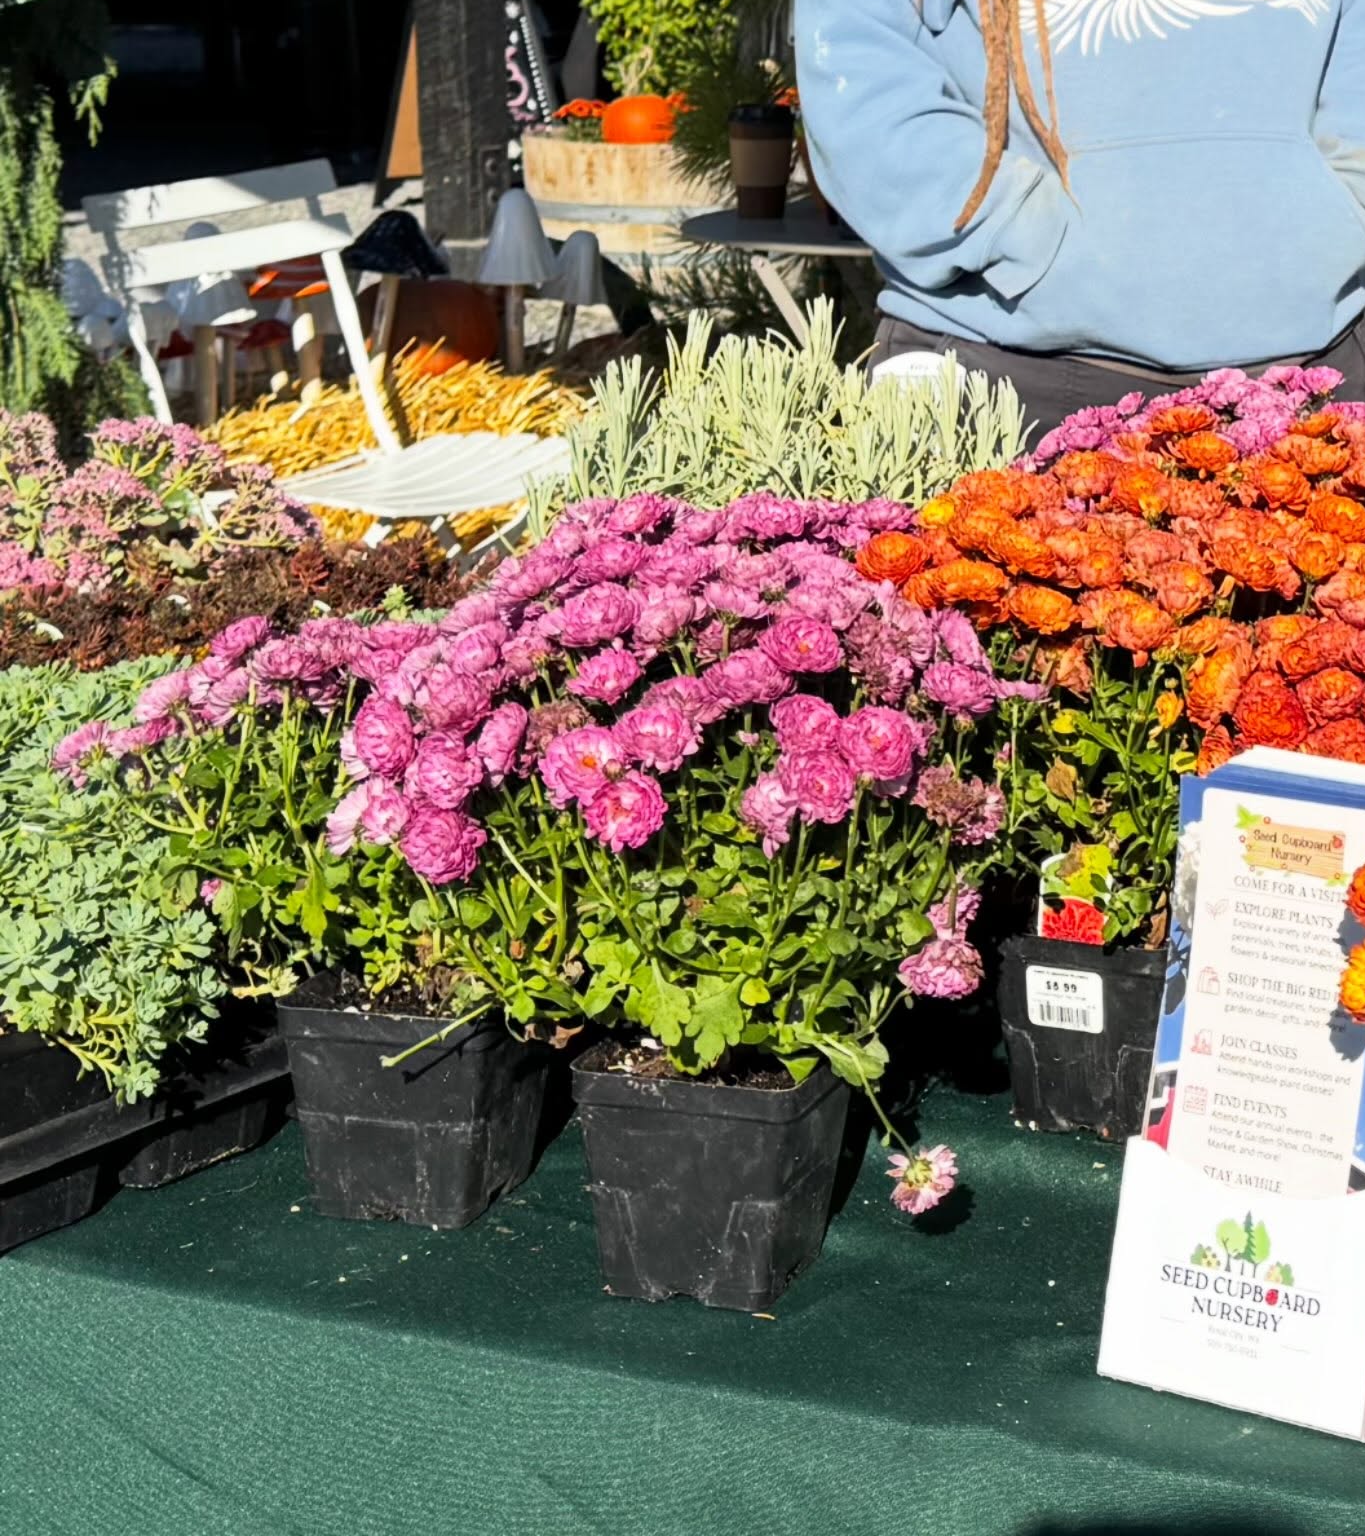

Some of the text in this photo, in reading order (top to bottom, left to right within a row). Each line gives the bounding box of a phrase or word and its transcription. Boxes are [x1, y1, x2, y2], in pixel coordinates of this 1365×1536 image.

[1253, 828, 1278, 844] Seed
[1271, 847, 1313, 865] Nursery
[1233, 874, 1270, 891] COME
[1272, 880, 1295, 898] FOR
[1298, 886, 1308, 898] A
[1235, 900, 1334, 930] EXPLORE PLANTS
[1227, 971, 1260, 990] SHOP
[1261, 977, 1283, 993] THE
[1286, 982, 1306, 997] BIG
[1220, 1034, 1299, 1060] JOIN CLASSES
[1213, 1092, 1288, 1120] FIND EVENTS
[1236, 1170, 1283, 1194] AWHILE
[1160, 1263, 1210, 1291] SEED
[1191, 1295, 1284, 1334] NURSERY
